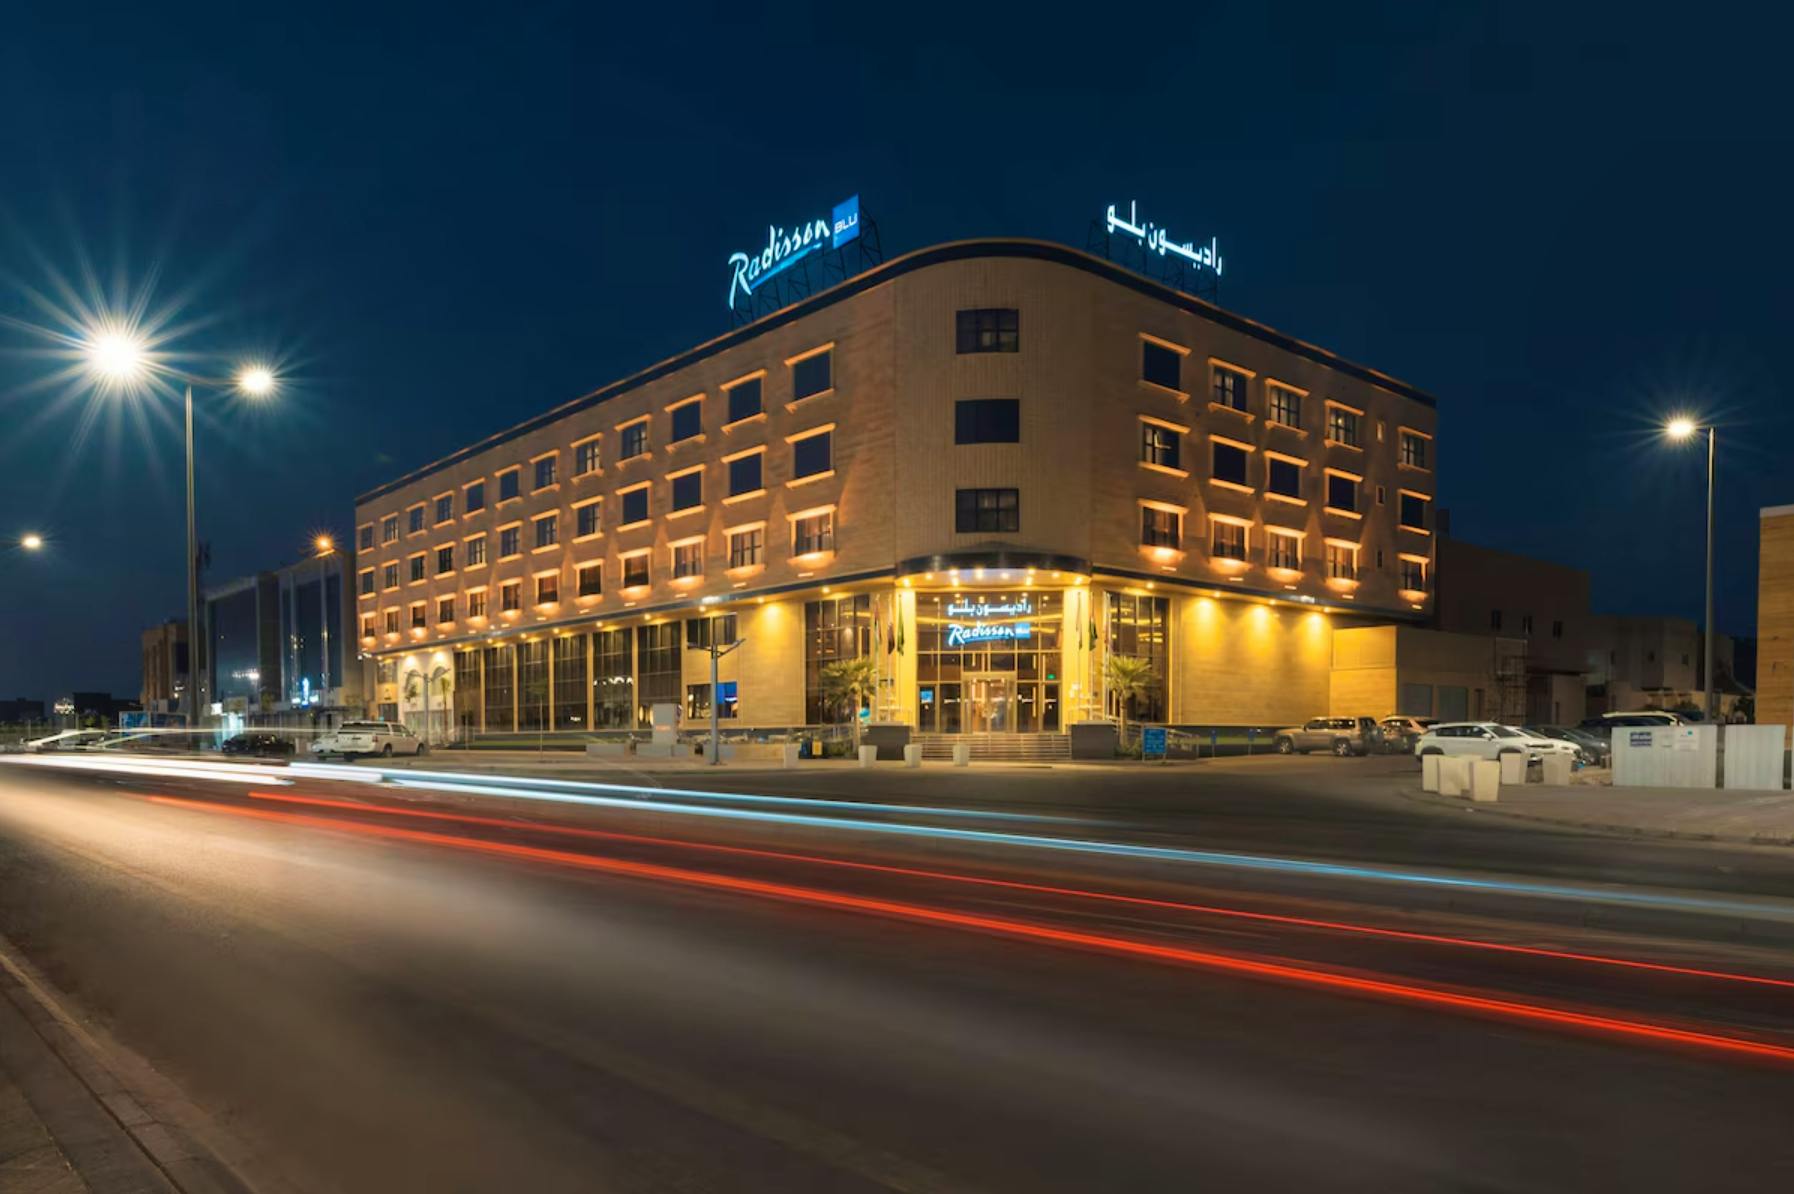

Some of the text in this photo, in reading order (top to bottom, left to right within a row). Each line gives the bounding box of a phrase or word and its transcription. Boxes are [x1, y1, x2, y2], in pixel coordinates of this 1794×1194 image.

[728, 213, 858, 309] Radisson BLU
[1106, 199, 1223, 276] راديسون بلو
[947, 620, 1015, 646] Radisson
